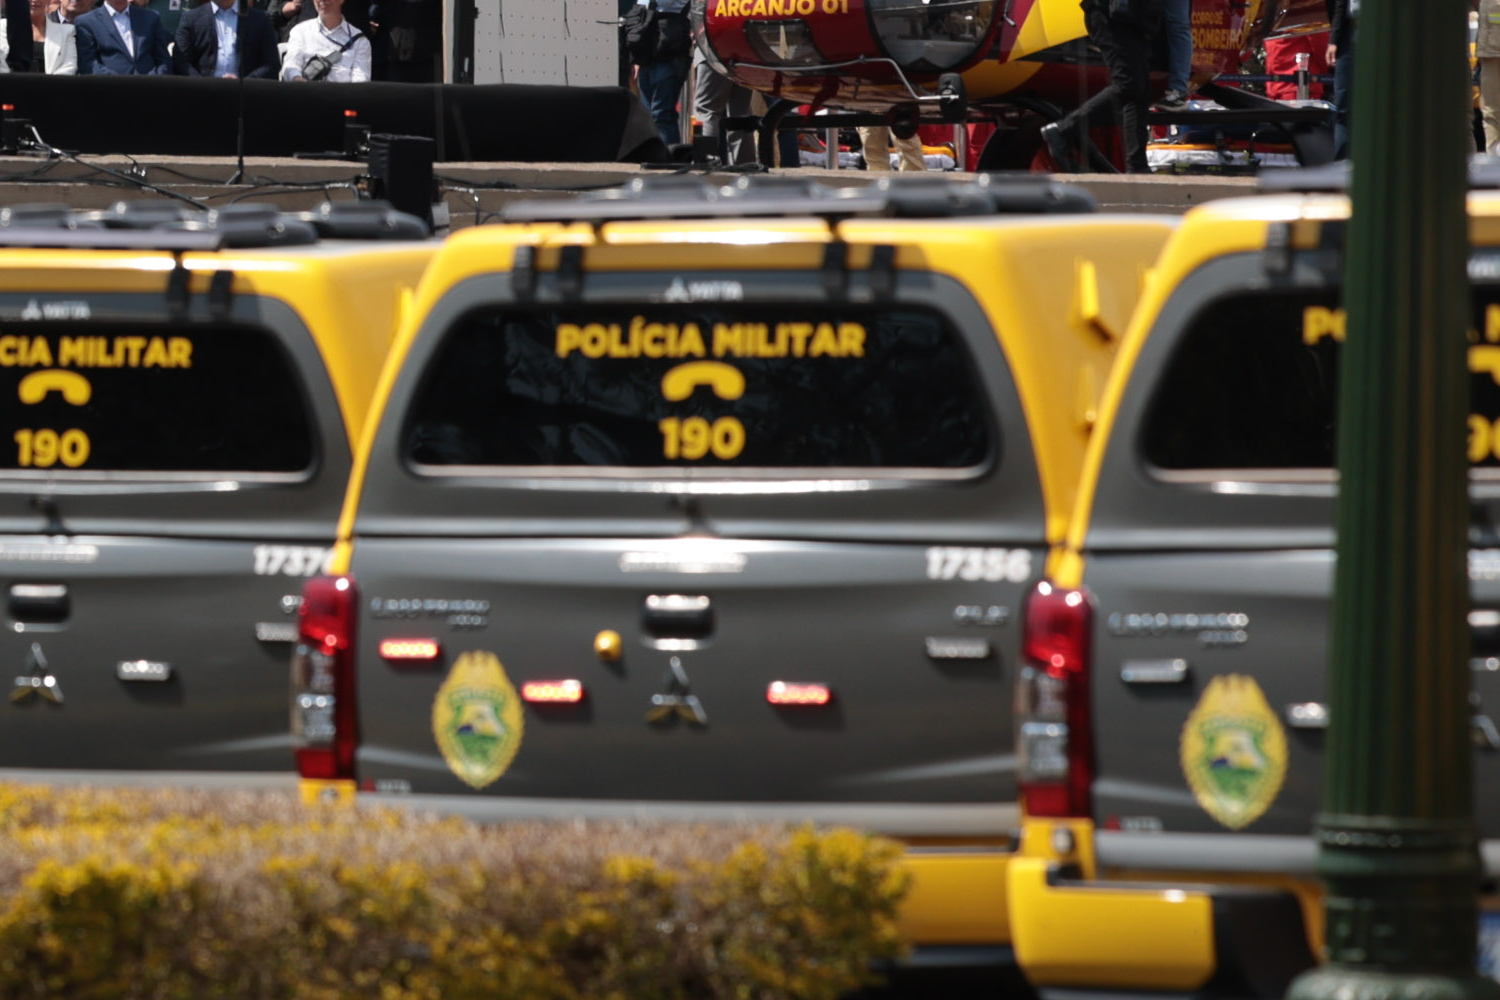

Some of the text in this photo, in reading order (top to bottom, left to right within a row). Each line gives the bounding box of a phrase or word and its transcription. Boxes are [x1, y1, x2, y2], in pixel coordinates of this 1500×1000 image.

[58, 336, 193, 368] MILITAR
[556, 315, 866, 358] POLÍCIA MILITAR
[14, 428, 90, 468] 190
[658, 416, 746, 461] 190
[925, 546, 1031, 583] 17356
